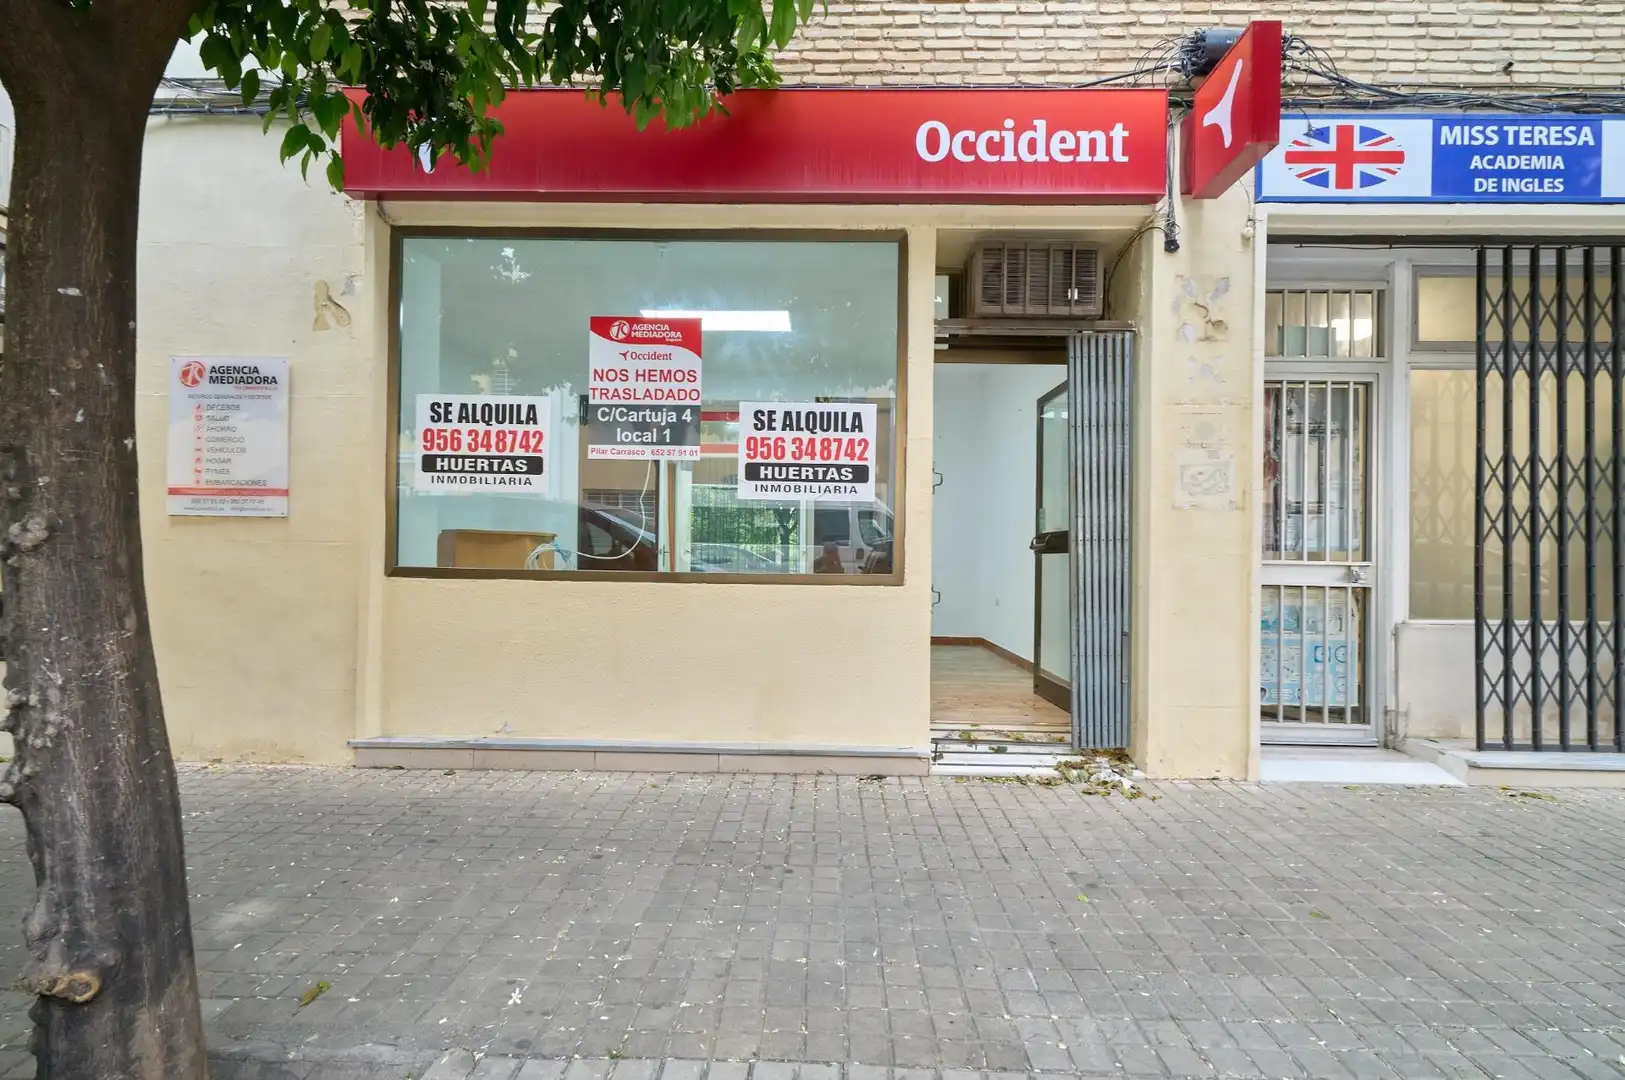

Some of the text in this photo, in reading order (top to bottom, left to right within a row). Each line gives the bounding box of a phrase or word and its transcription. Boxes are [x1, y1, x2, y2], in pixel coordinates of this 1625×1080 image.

[915, 118, 1129, 163] Occident
[1440, 125, 1595, 146] MISS TERESA
[1470, 155, 1565, 170] ACADEMIA
[1474, 177, 1564, 193] DE INGLES
[630, 351, 672, 360] Occident
[209, 365, 260, 375] AGENCIA
[593, 368, 697, 383] NOS HEMOS
[208, 375, 278, 385] MEDIADORA
[590, 387, 701, 401] TRASLADADO
[430, 402, 538, 426] SE ALQUILA
[597, 407, 692, 426] C/Cartuja 4
[753, 410, 863, 434] SE ALQUILA
[423, 428, 462, 452] 956
[616, 428, 671, 442] local 1
[590, 447, 608, 455] Pilar
[610, 448, 646, 456] Carrasco
[650, 448, 665, 456] 652
[678, 449, 687, 457] 91
[689, 449, 698, 457] 01
[746, 437, 786, 460] 956
[436, 458, 528, 472] HUERTAS
[760, 466, 853, 480] HUERTAS
[431, 475, 533, 486] INMOBILIARIA
[754, 484, 858, 494] INMOBILIARIA
